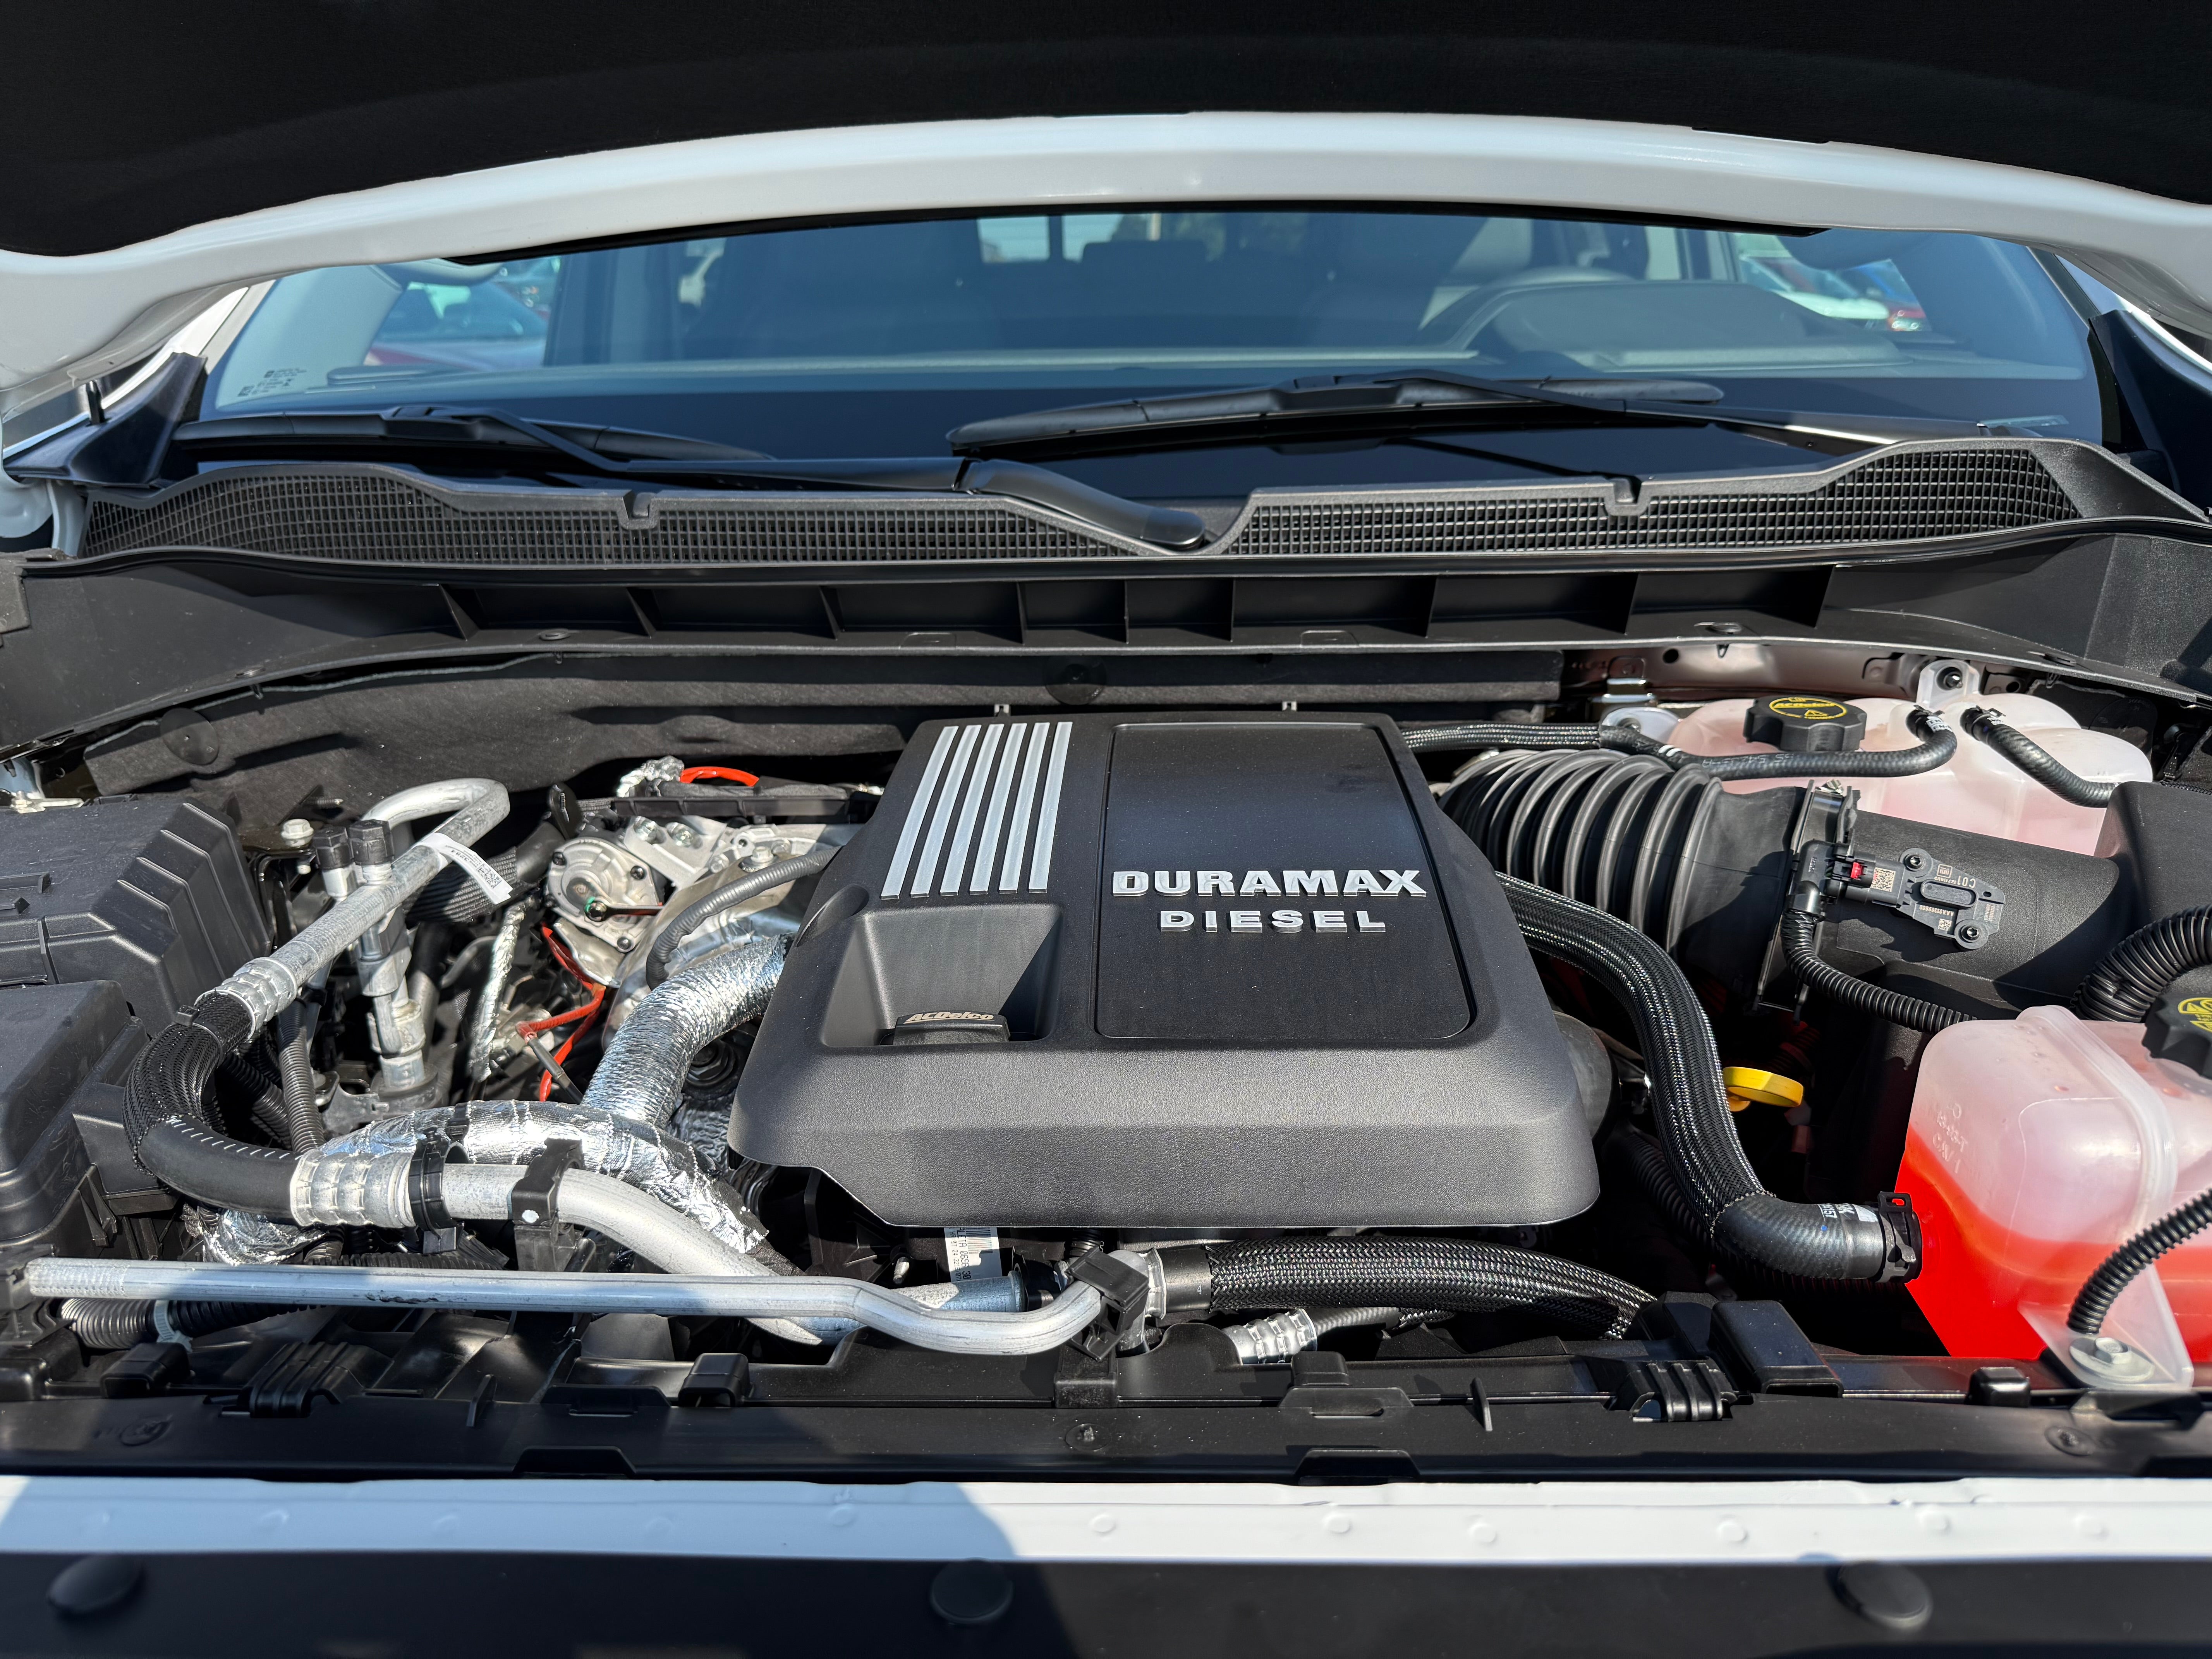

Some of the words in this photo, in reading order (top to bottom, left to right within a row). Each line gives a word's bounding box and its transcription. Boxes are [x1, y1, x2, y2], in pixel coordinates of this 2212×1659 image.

[1112, 869, 1427, 897] DURAMAX
[1160, 909, 1386, 933] DIESEL
[905, 1012, 994, 1022] ACDelco
[962, 1271, 972, 1280] 30
